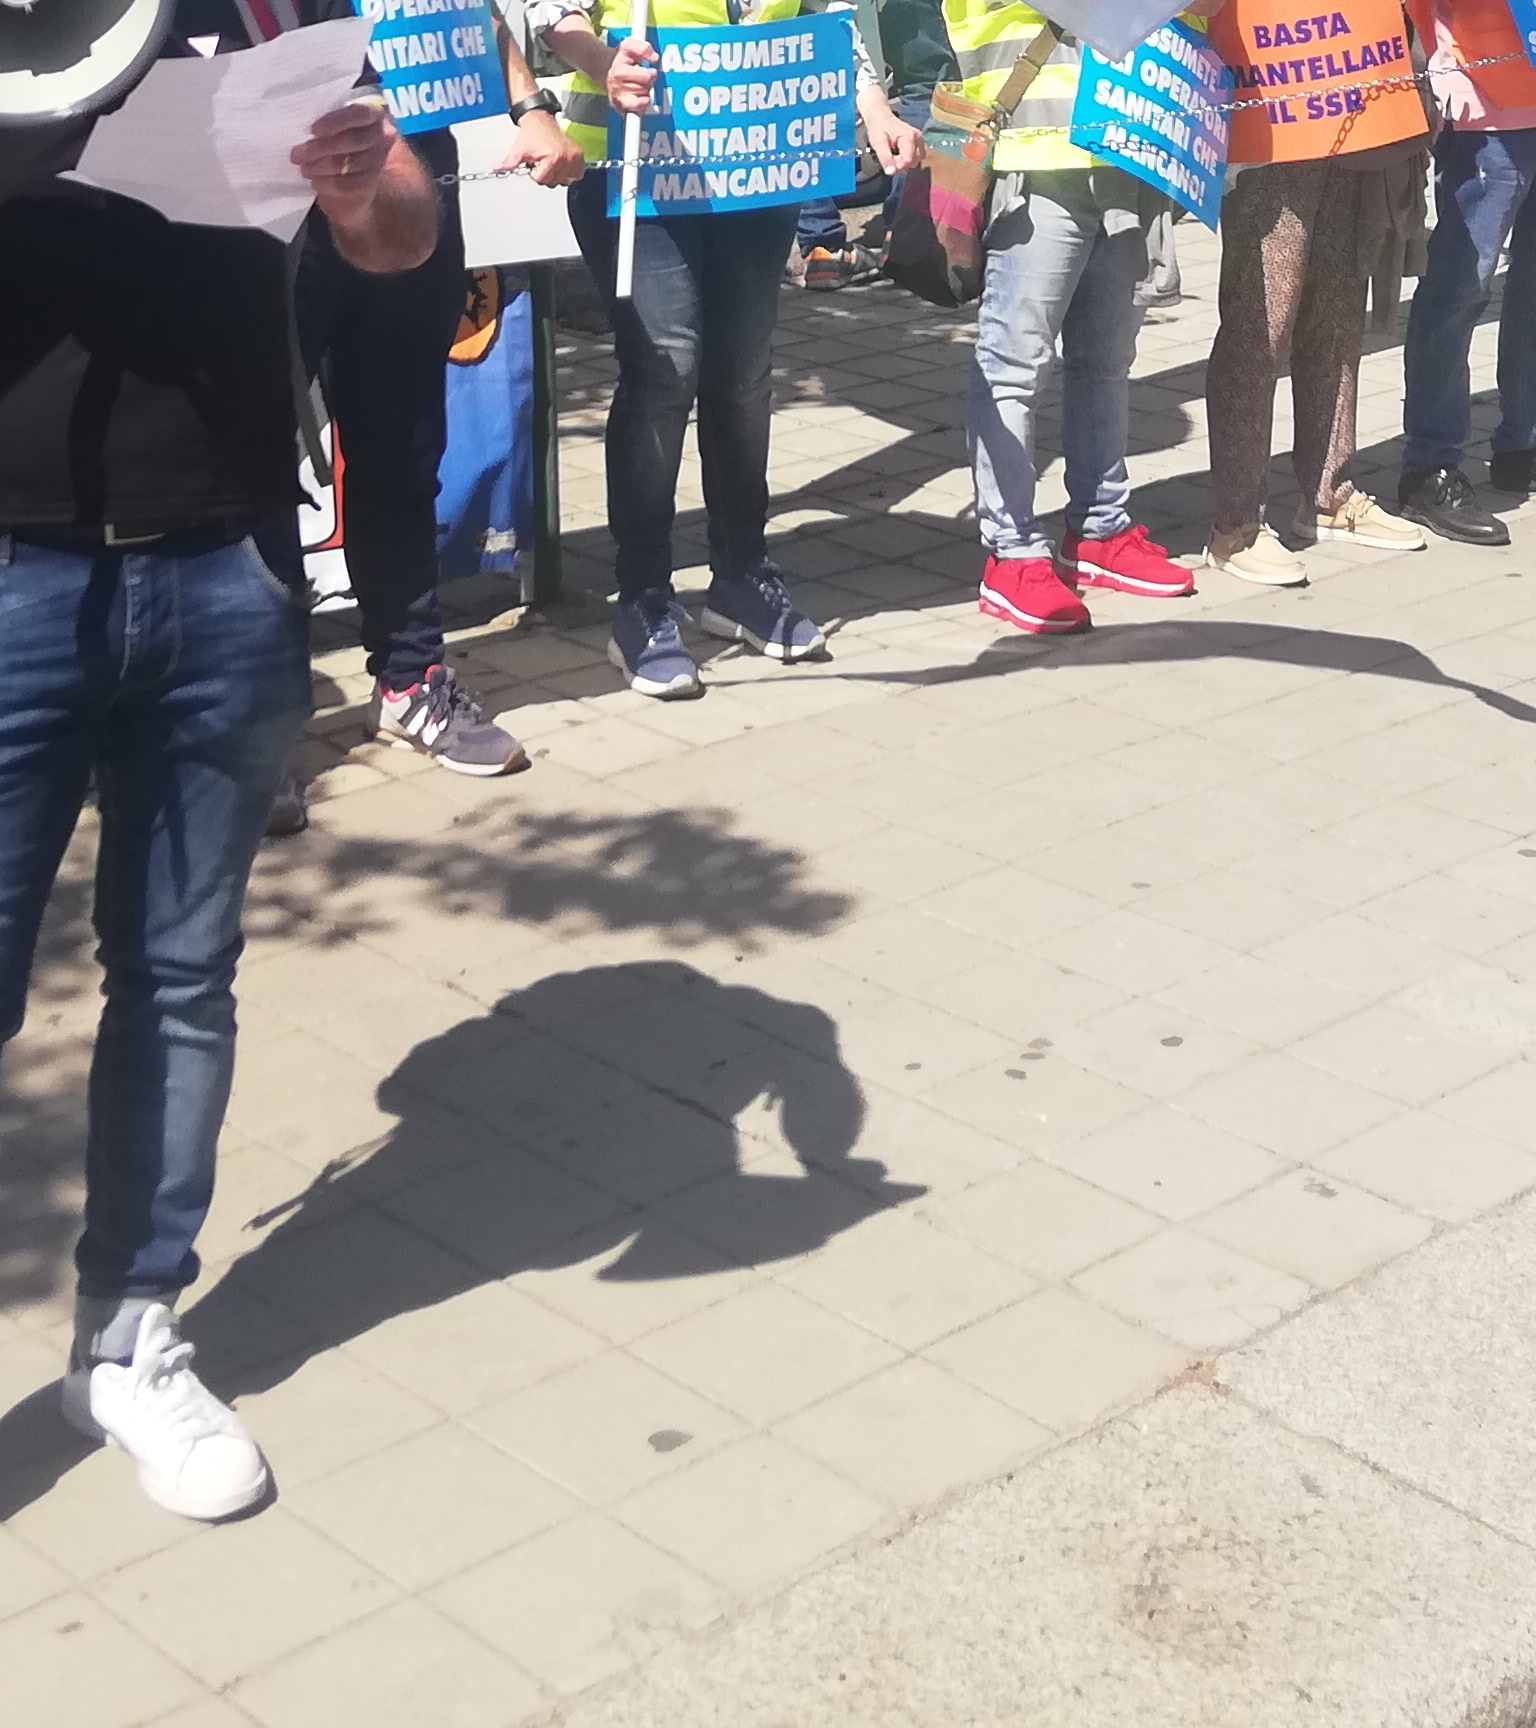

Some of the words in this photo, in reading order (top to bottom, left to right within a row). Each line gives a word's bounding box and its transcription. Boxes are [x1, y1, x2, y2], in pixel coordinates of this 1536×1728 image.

[451, 25, 487, 59] CHE
[659, 32, 814, 73] ASSUMETE
[1253, 12, 1351, 49] BASTA
[1144, 27, 1217, 93] SSUMETE
[383, 73, 484, 120] ANCANO!
[684, 69, 846, 116] OPERATORI
[1140, 59, 1227, 144] OPERATORI
[1267, 98, 1297, 124] IL
[1306, 89, 1365, 120] SSR
[638, 123, 777, 159] SANITARI
[786, 113, 837, 147] CHE
[1094, 78, 1191, 151] SANITARI
[1193, 135, 1218, 177] CHE
[652, 157, 820, 202] MANCANO!
